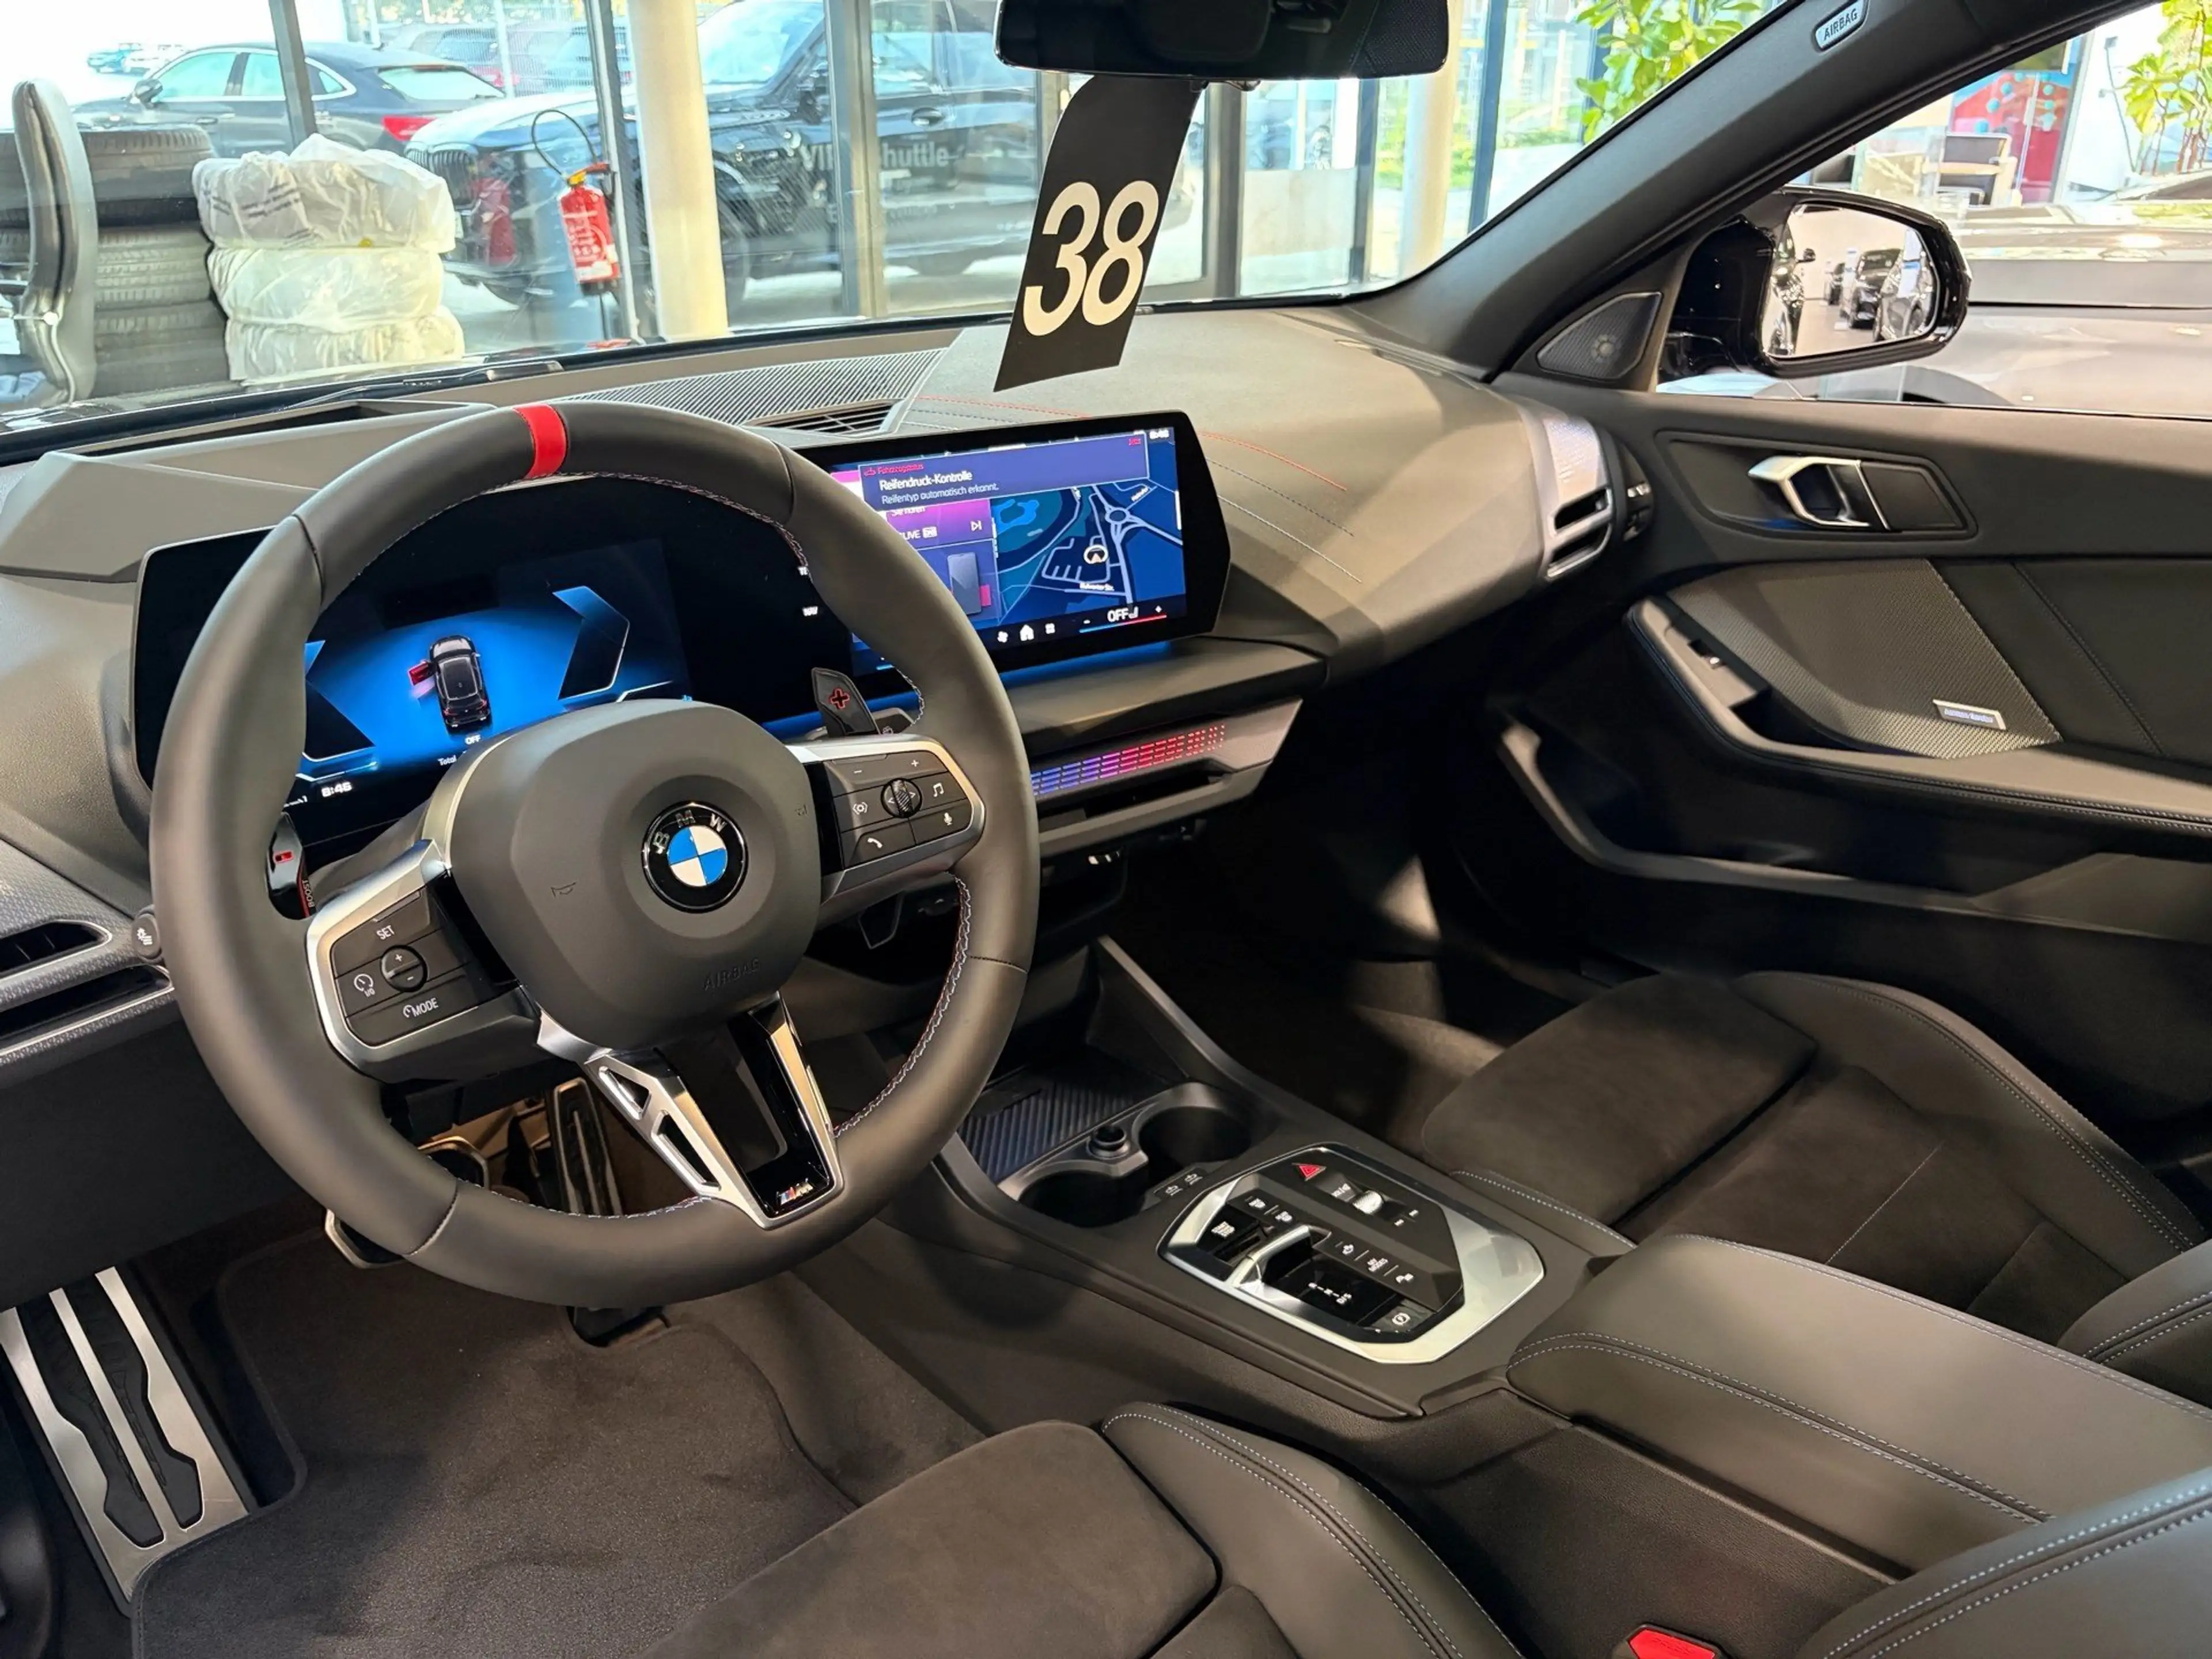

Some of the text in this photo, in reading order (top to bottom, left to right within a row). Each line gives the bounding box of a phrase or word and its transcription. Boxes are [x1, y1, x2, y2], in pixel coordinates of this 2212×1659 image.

[1823, 8, 1858, 41] AIRBAG
[881, 142, 949, 168] huttle
[1023, 180, 1159, 336] 38
[878, 470, 973, 491] Reifendruck-Kontrolle
[881, 483, 999, 505] Reifentyp automatisch erkannt.
[1107, 608, 1129, 623] OFF
[465, 734, 481, 745] OFF
[438, 754, 457, 766] Total
[652, 809, 728, 855] BMW
[302, 878, 315, 908] BOOST
[376, 925, 395, 940] SET
[412, 997, 439, 1017] MODE
